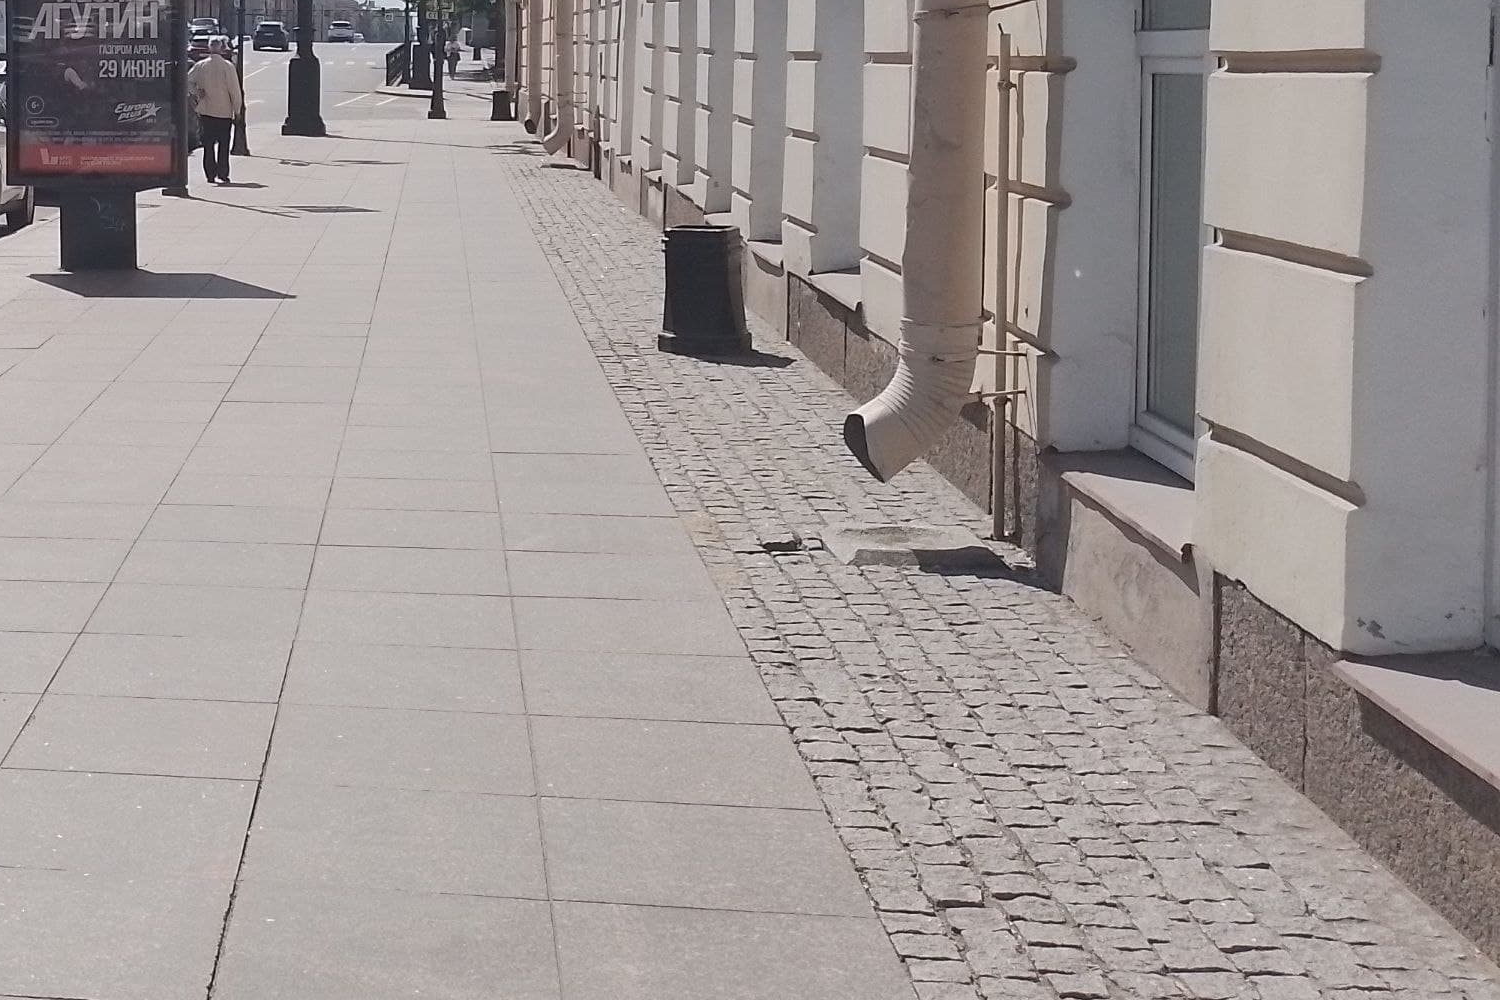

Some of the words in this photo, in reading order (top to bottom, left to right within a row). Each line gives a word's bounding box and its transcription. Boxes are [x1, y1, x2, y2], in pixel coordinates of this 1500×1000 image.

[28, 1, 159, 41] АГУТИН
[99, 44, 132, 55] ГАЗПРОМ
[133, 44, 158, 55] АРЕНА
[98, 59, 118, 79] 29
[120, 59, 166, 78] ИЮНЯ
